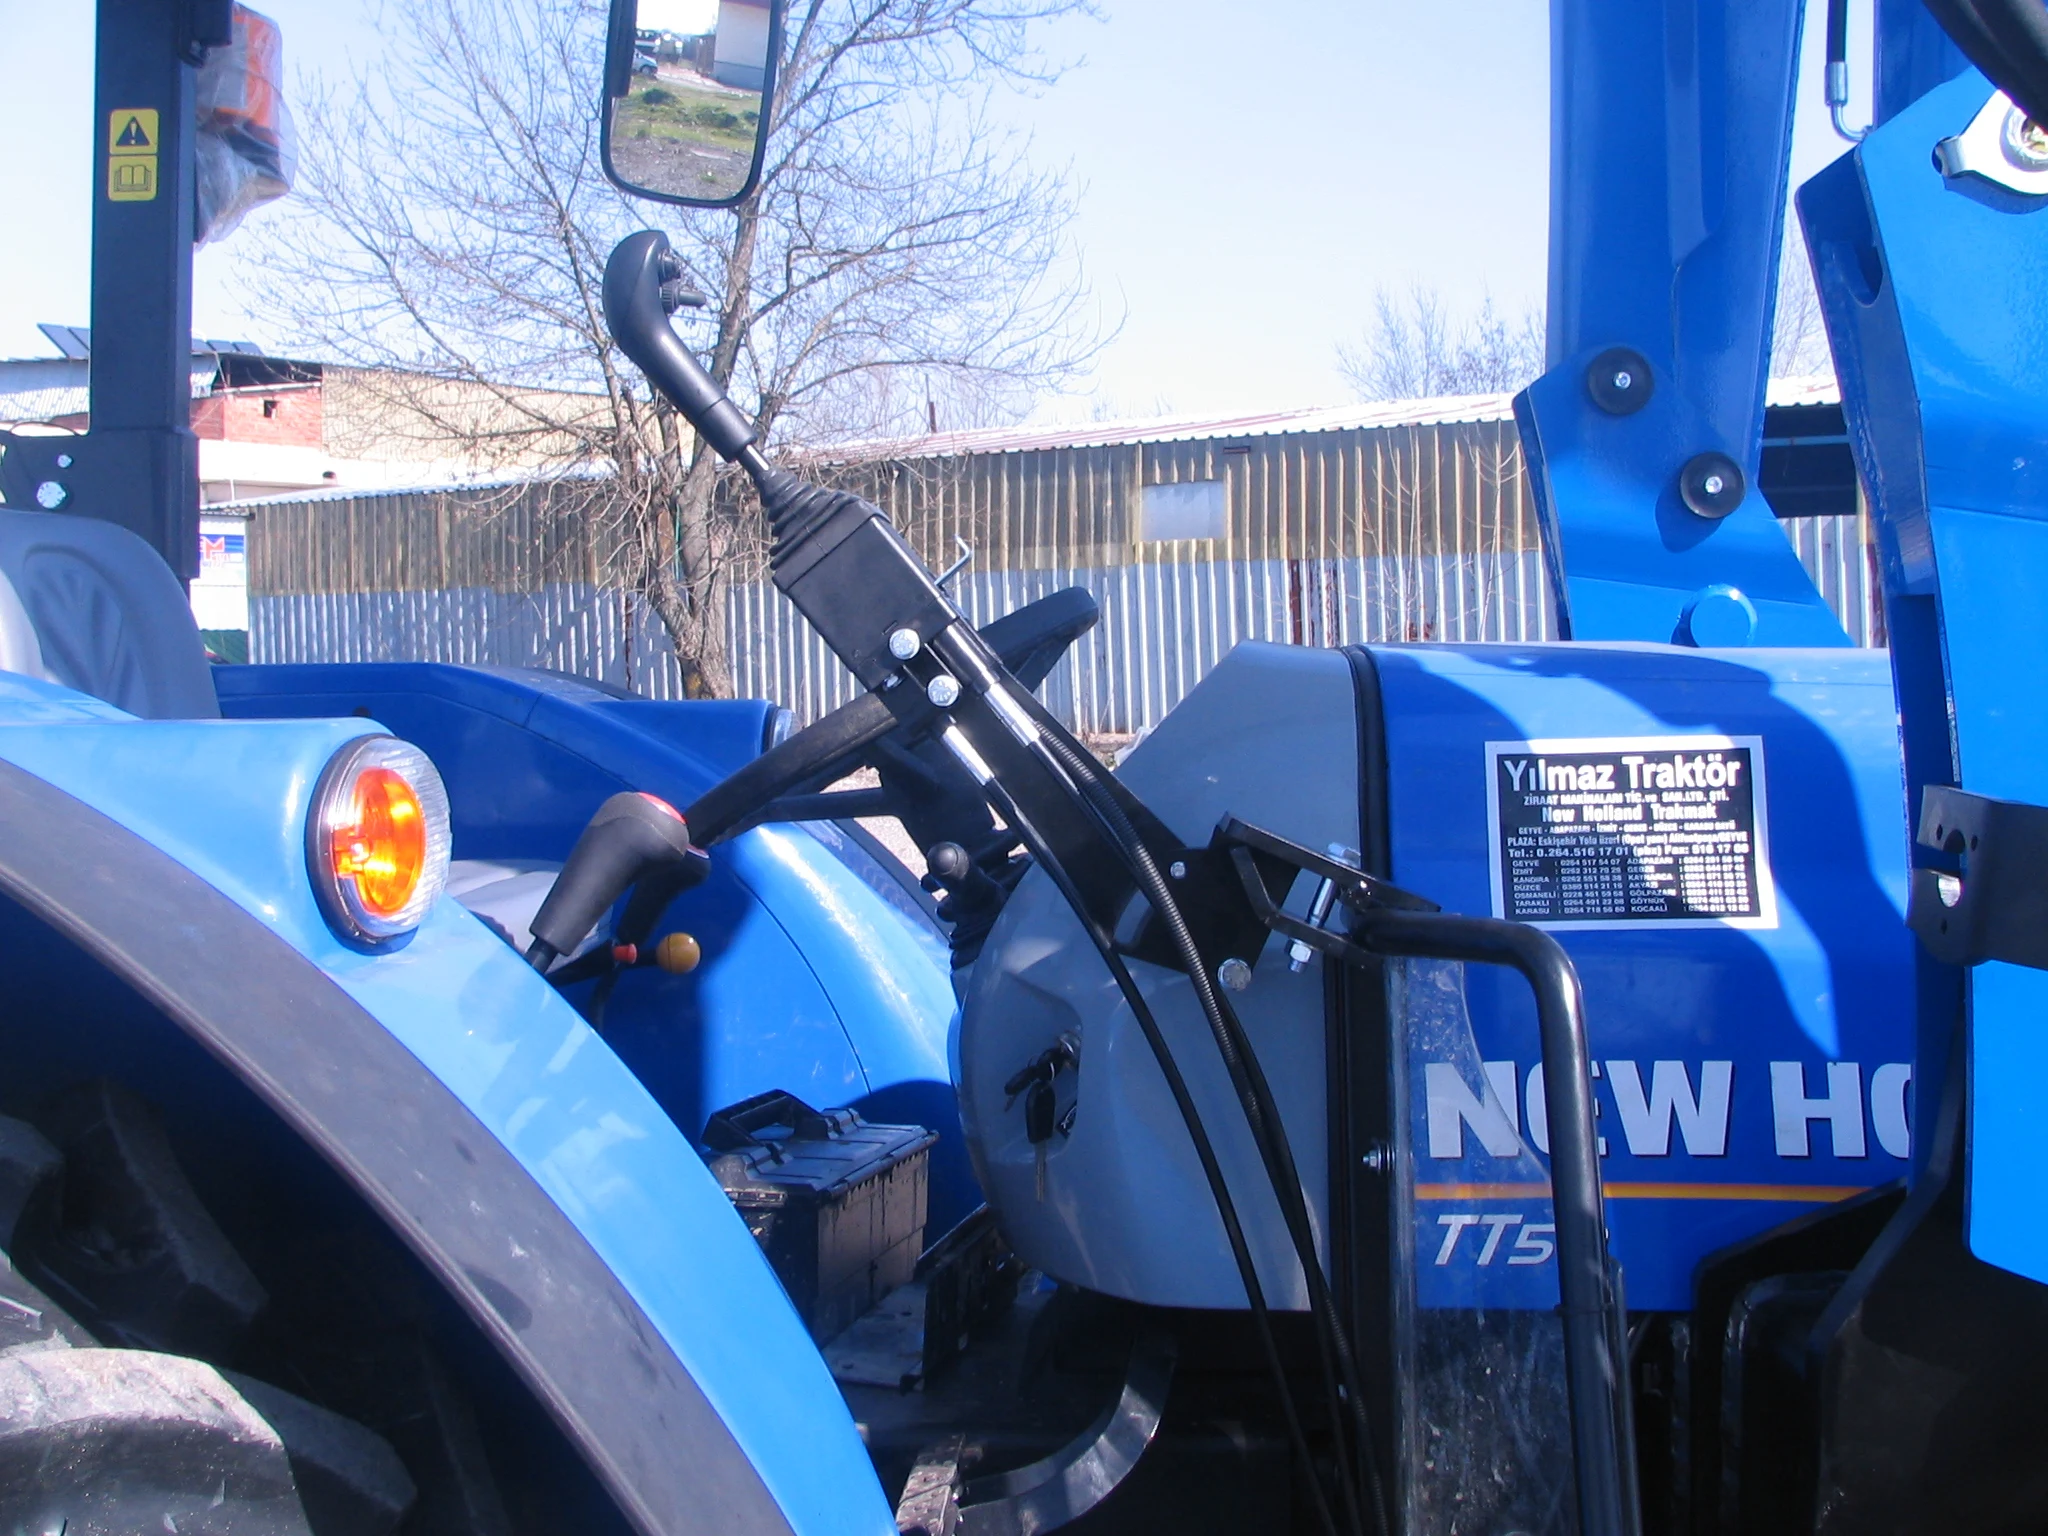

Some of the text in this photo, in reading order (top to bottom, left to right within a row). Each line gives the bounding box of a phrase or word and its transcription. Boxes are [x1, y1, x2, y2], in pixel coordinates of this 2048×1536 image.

[1504, 753, 1741, 792] Yılmaz Traktör
[1542, 802, 1717, 822] New Holland Trakmak
[1508, 836, 1536, 846] PLAZA:
[1508, 848, 1534, 858] Tel.:
[1536, 848, 1594, 857] 0.264.516
[1598, 847, 1612, 856] 17
[1615, 847, 1628, 856] 01
[1664, 844, 1689, 855] Fax:
[1717, 844, 1731, 854] 17
